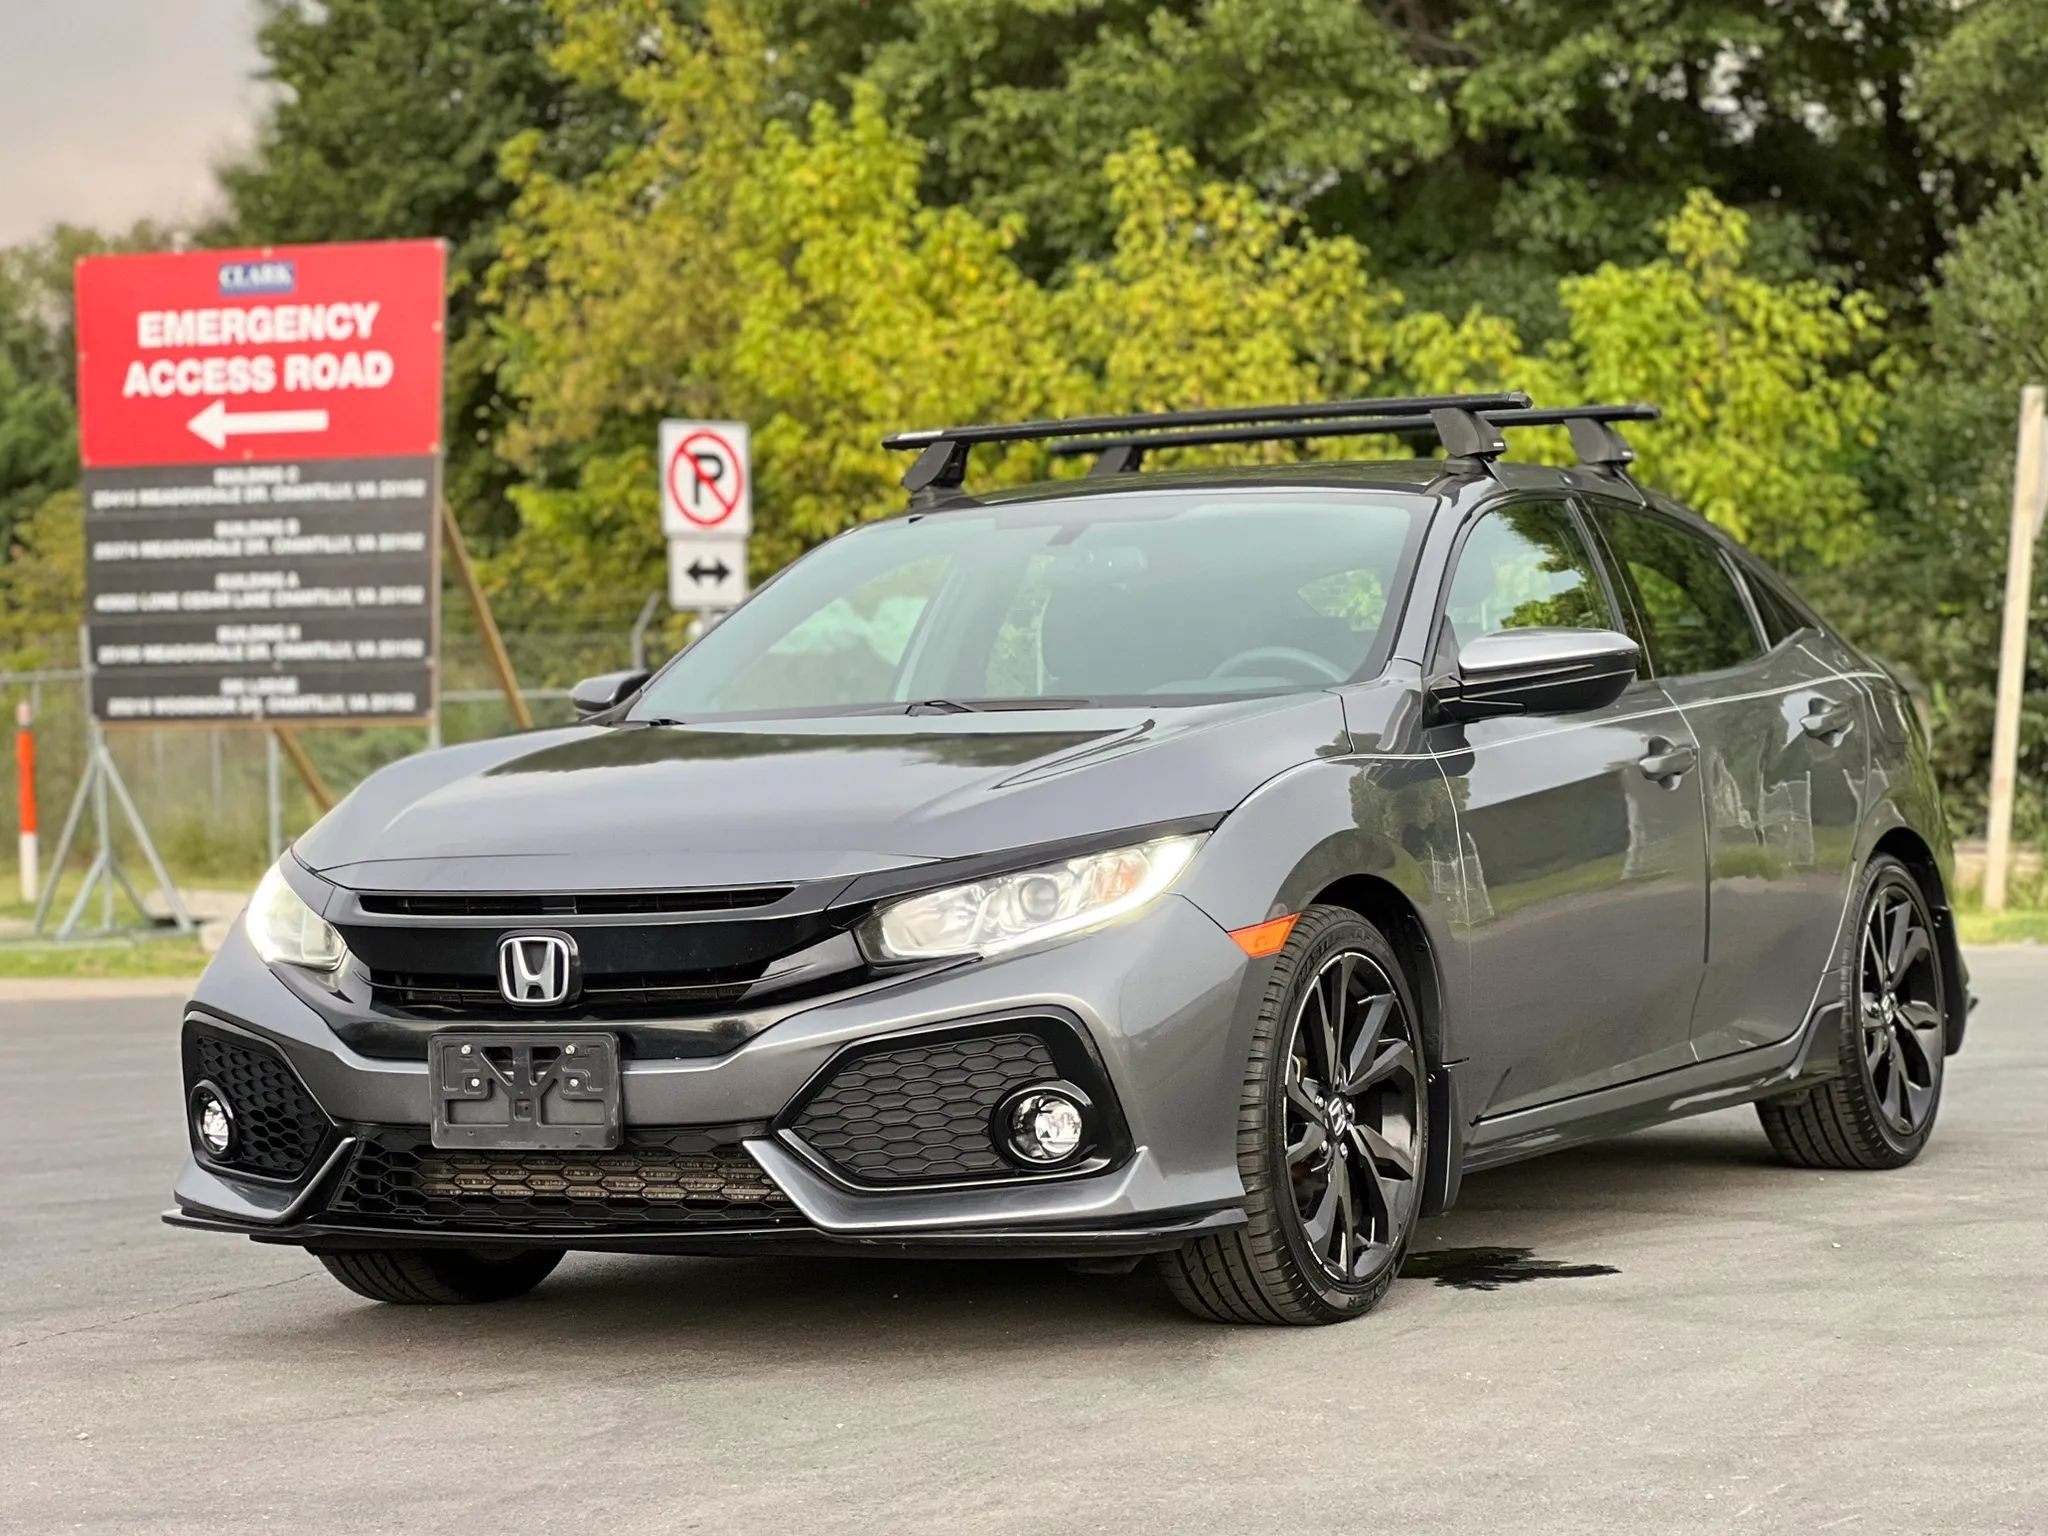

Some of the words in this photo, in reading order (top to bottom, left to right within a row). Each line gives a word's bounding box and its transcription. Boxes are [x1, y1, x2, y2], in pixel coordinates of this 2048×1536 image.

[138, 302, 380, 348] EMERGENCY
[122, 355, 276, 398] ACCESS
[284, 350, 394, 391] ROAD
